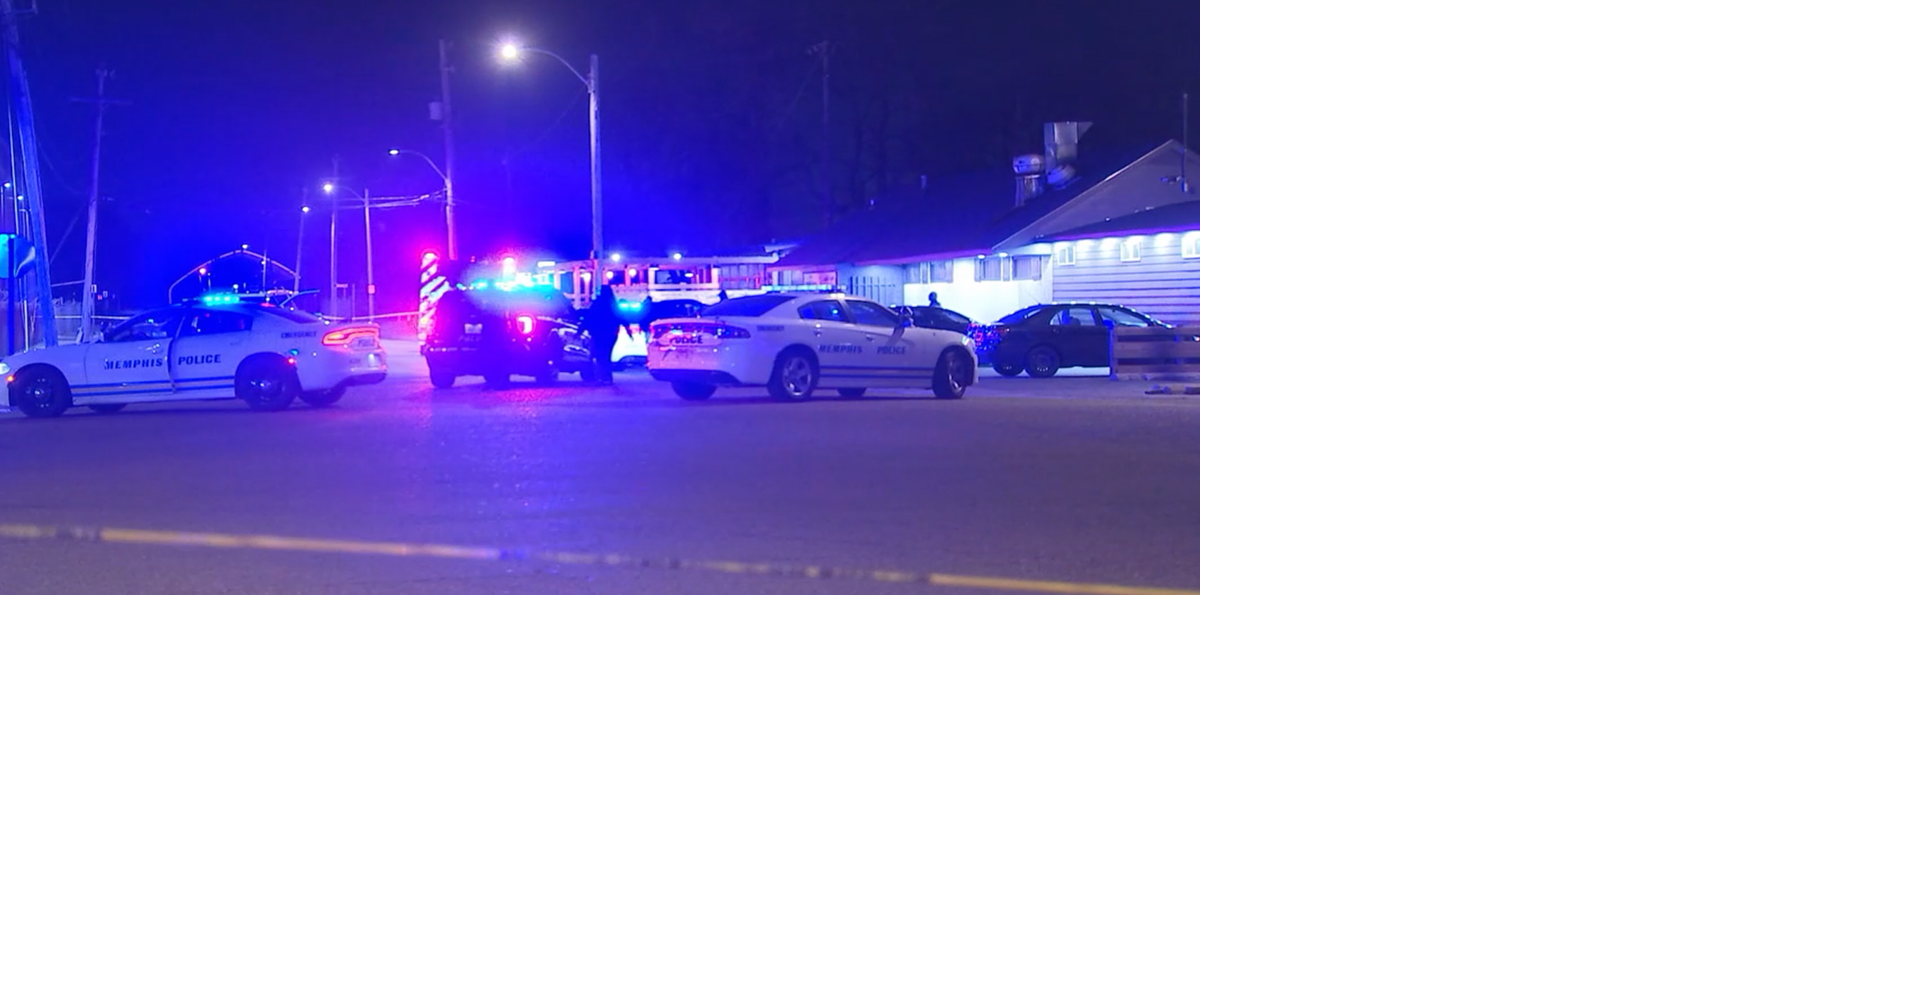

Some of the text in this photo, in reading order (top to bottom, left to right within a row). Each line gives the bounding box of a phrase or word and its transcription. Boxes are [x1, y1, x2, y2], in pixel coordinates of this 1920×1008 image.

[819, 345, 906, 355] MEMPHIS POLICE
[104, 354, 222, 370] MEMPHIS POLICE
